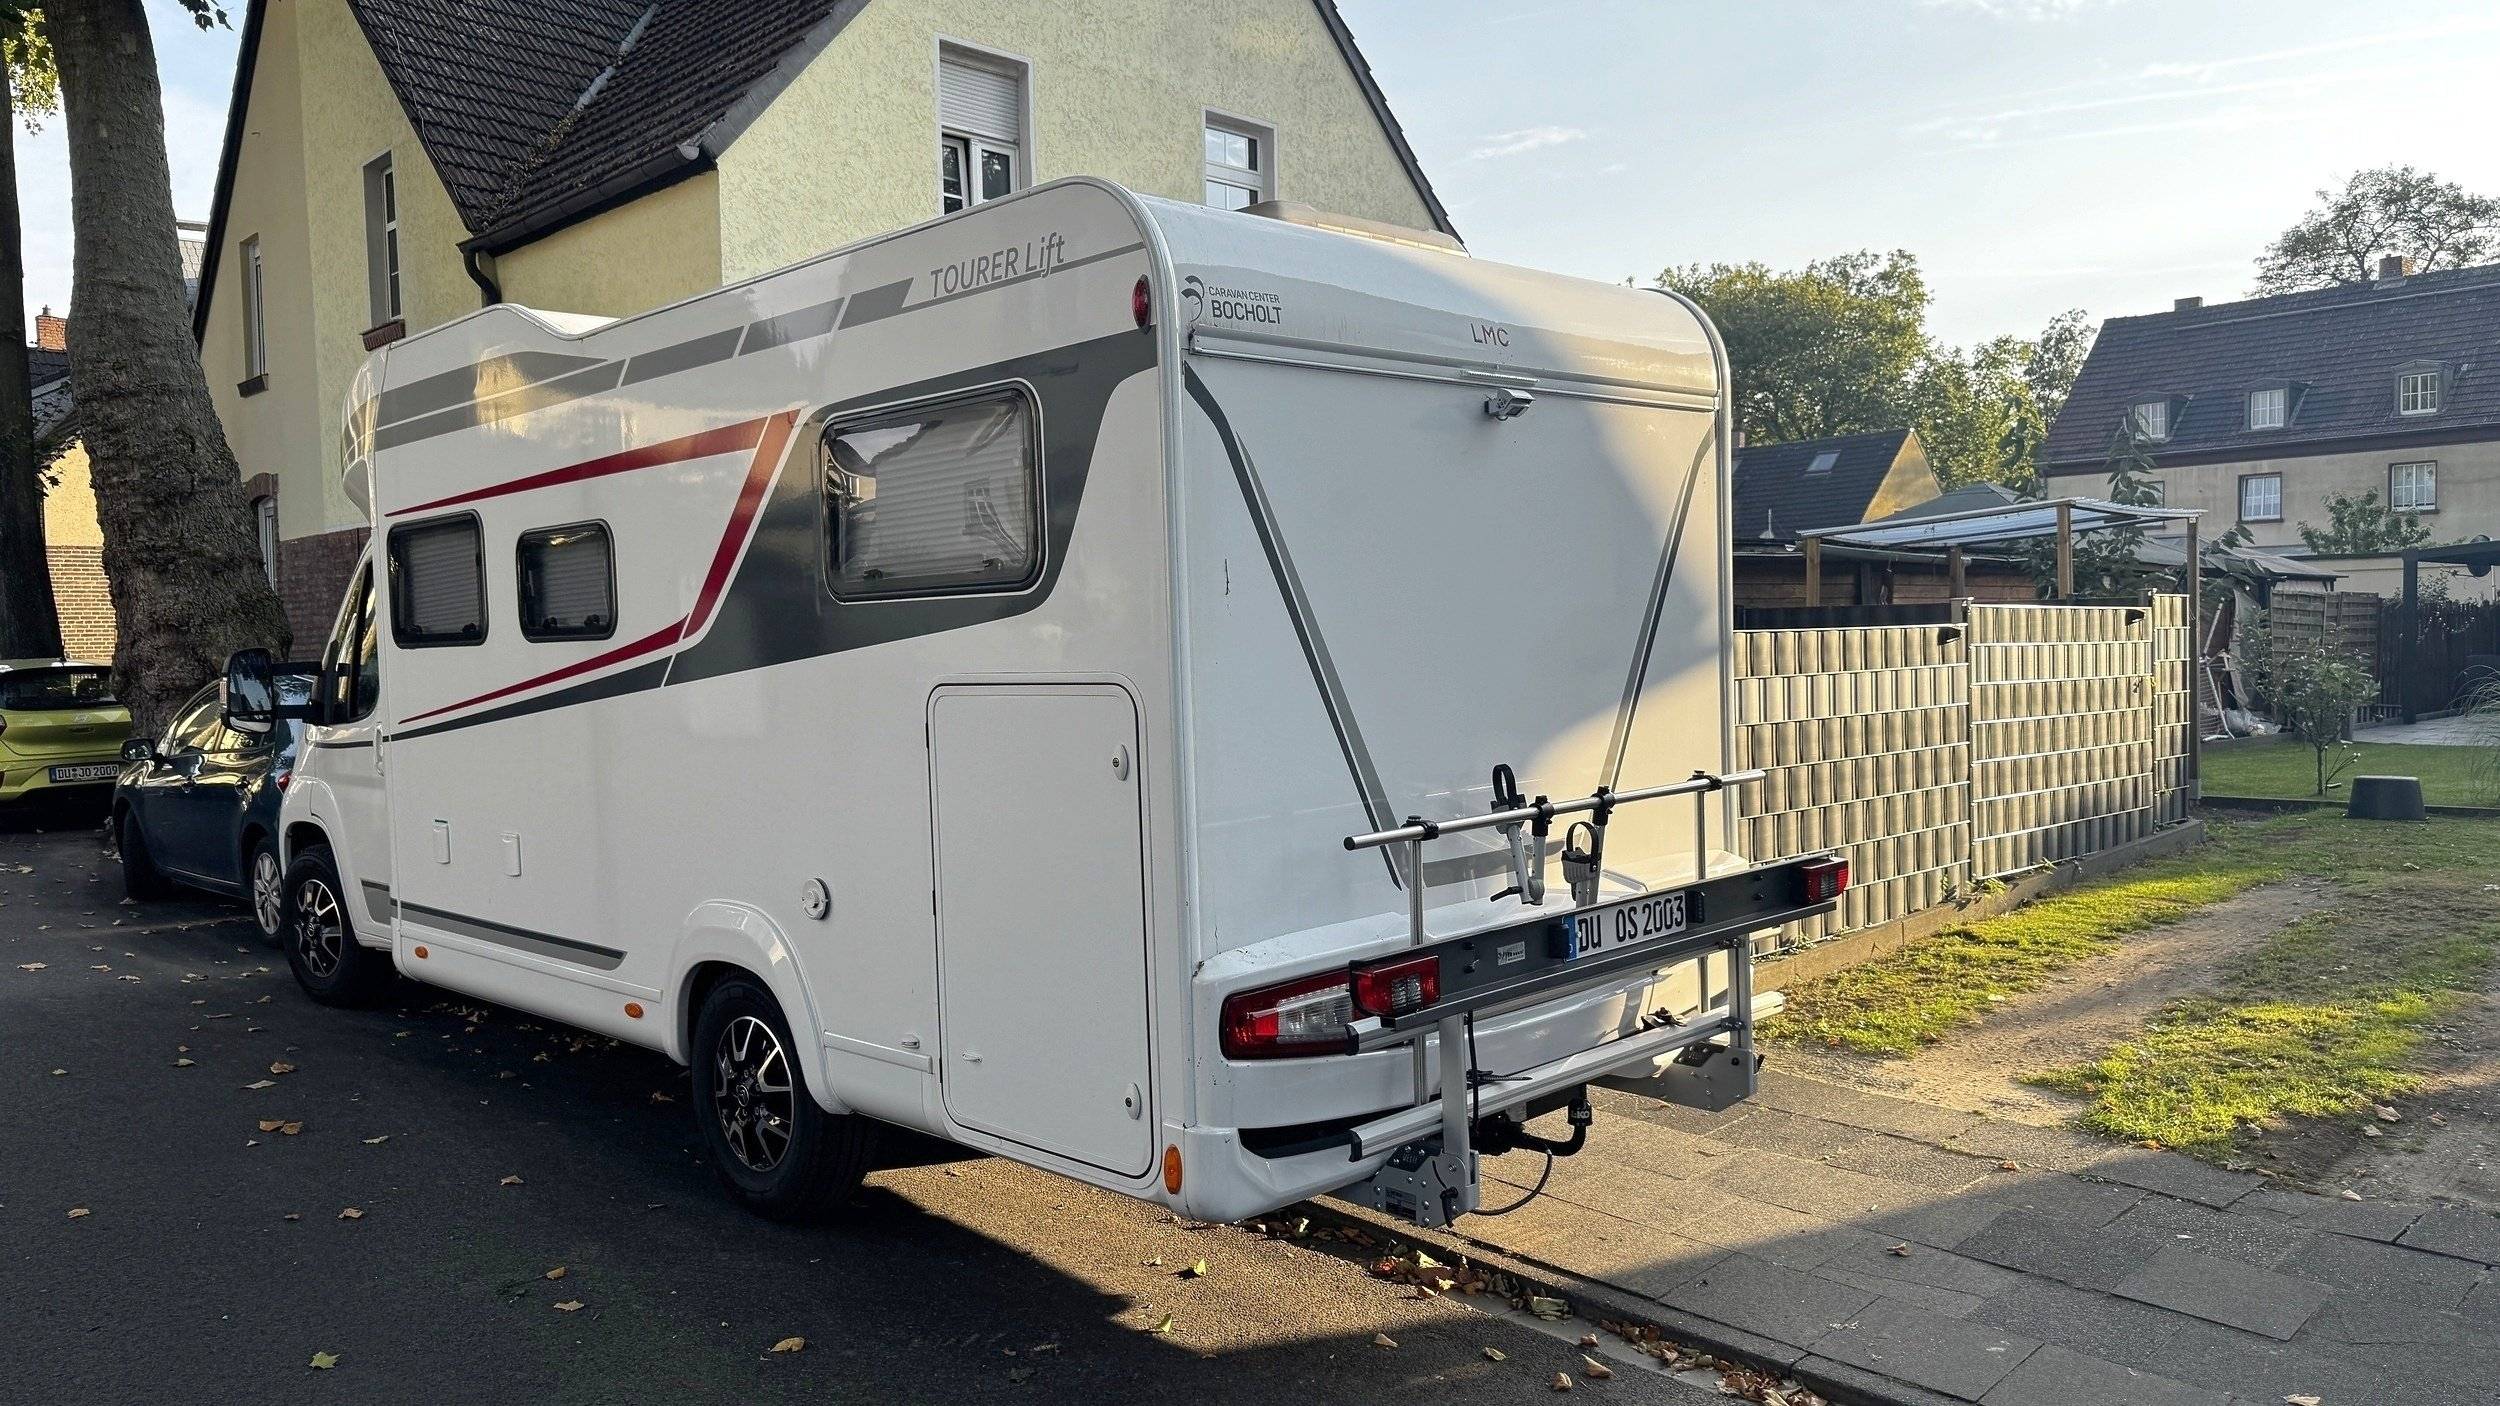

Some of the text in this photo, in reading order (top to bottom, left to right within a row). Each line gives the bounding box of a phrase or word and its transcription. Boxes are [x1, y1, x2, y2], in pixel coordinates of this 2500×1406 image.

[930, 231, 1065, 298] TOURER Lift
[1208, 286, 1280, 304] CARAVAN CENTER
[1211, 299, 1282, 325] BOCHOLT
[1470, 323, 1509, 347] LMC
[1578, 894, 1684, 953] DU OS 2003
